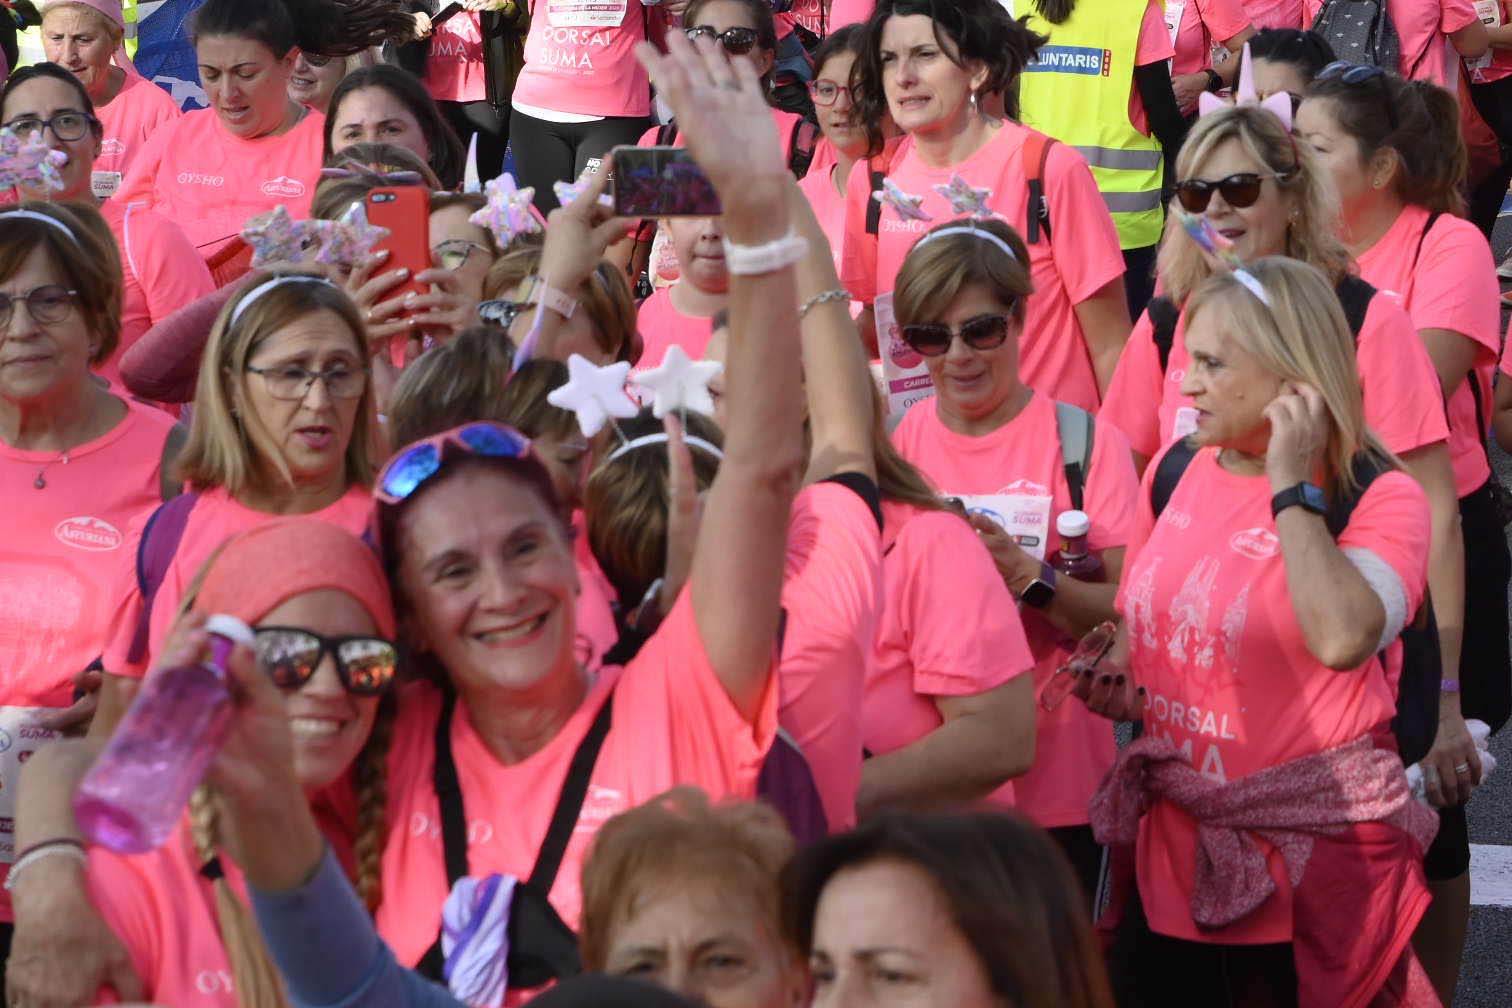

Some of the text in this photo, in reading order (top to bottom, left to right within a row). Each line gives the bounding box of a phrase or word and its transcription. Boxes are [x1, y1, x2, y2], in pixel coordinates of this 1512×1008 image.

[539, 47, 592, 69] SUMA
[1027, 49, 1100, 69] LUNTARIS
[177, 172, 225, 187] OYSHO
